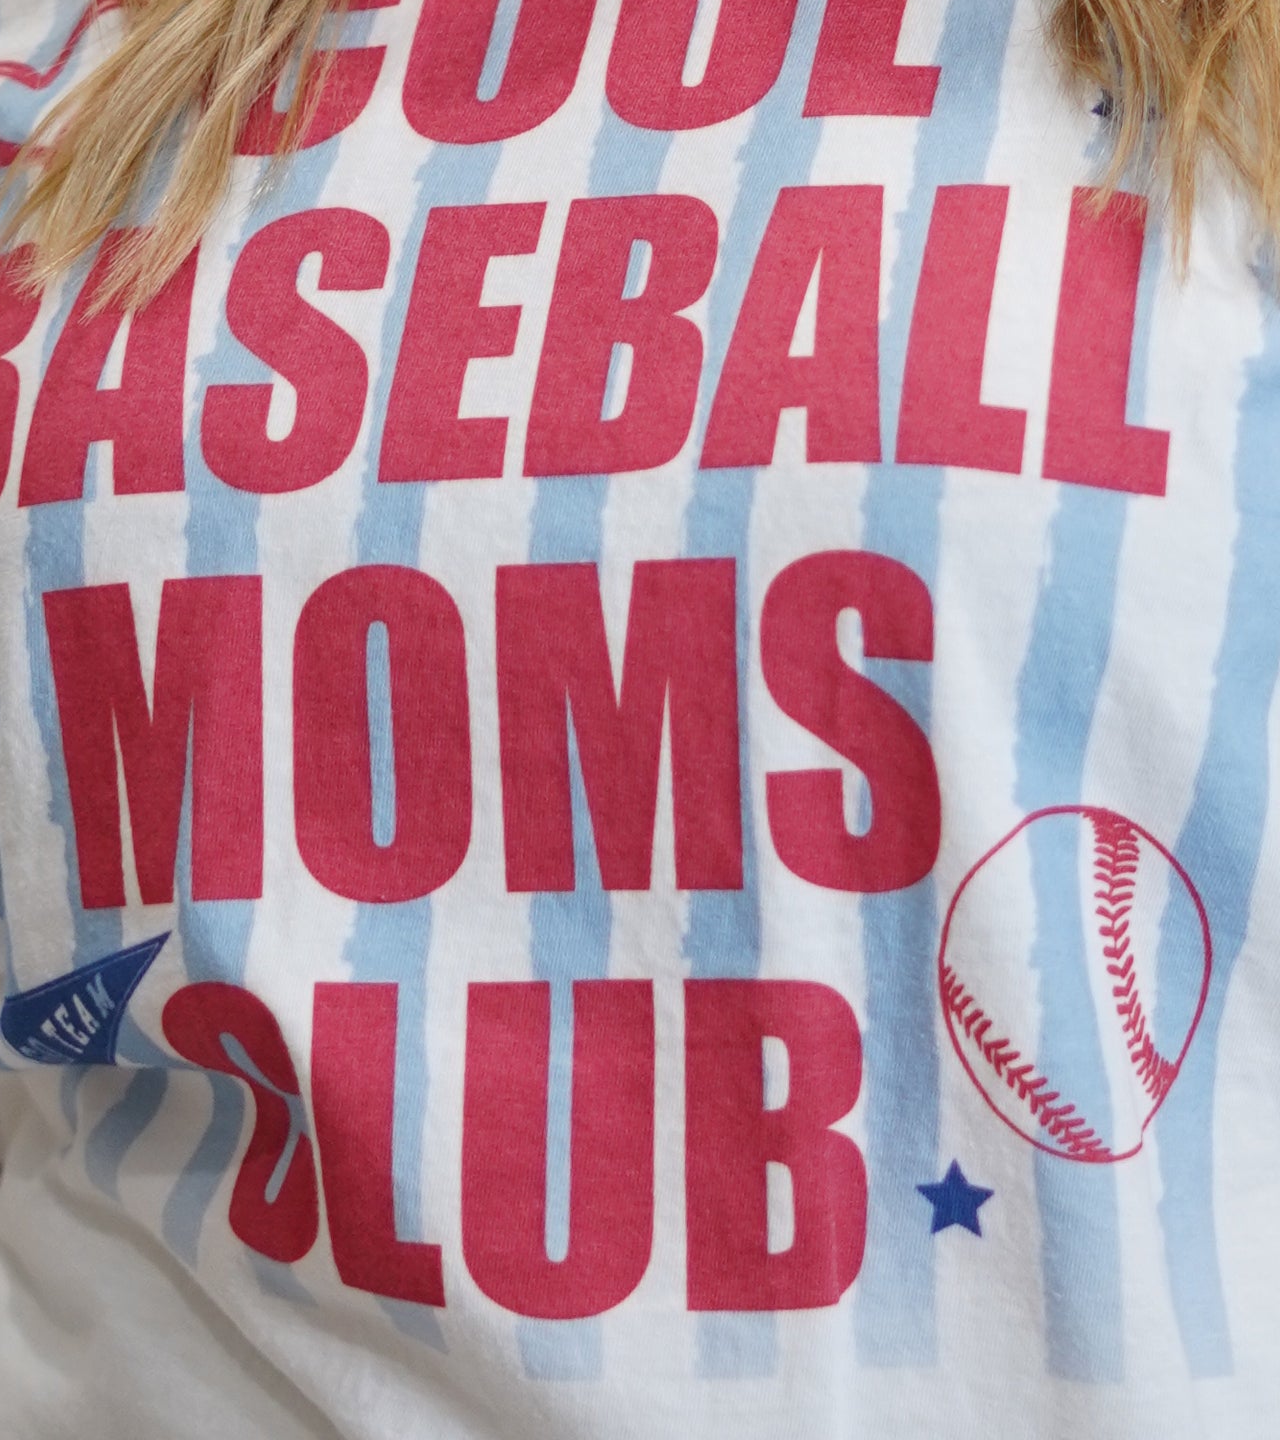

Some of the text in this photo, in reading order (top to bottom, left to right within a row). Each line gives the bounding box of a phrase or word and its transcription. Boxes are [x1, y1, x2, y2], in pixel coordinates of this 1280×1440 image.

[42, 550, 942, 910] MOMS
[40, 972, 116, 1054] TEAM
[162, 980, 868, 1320] CLUB
